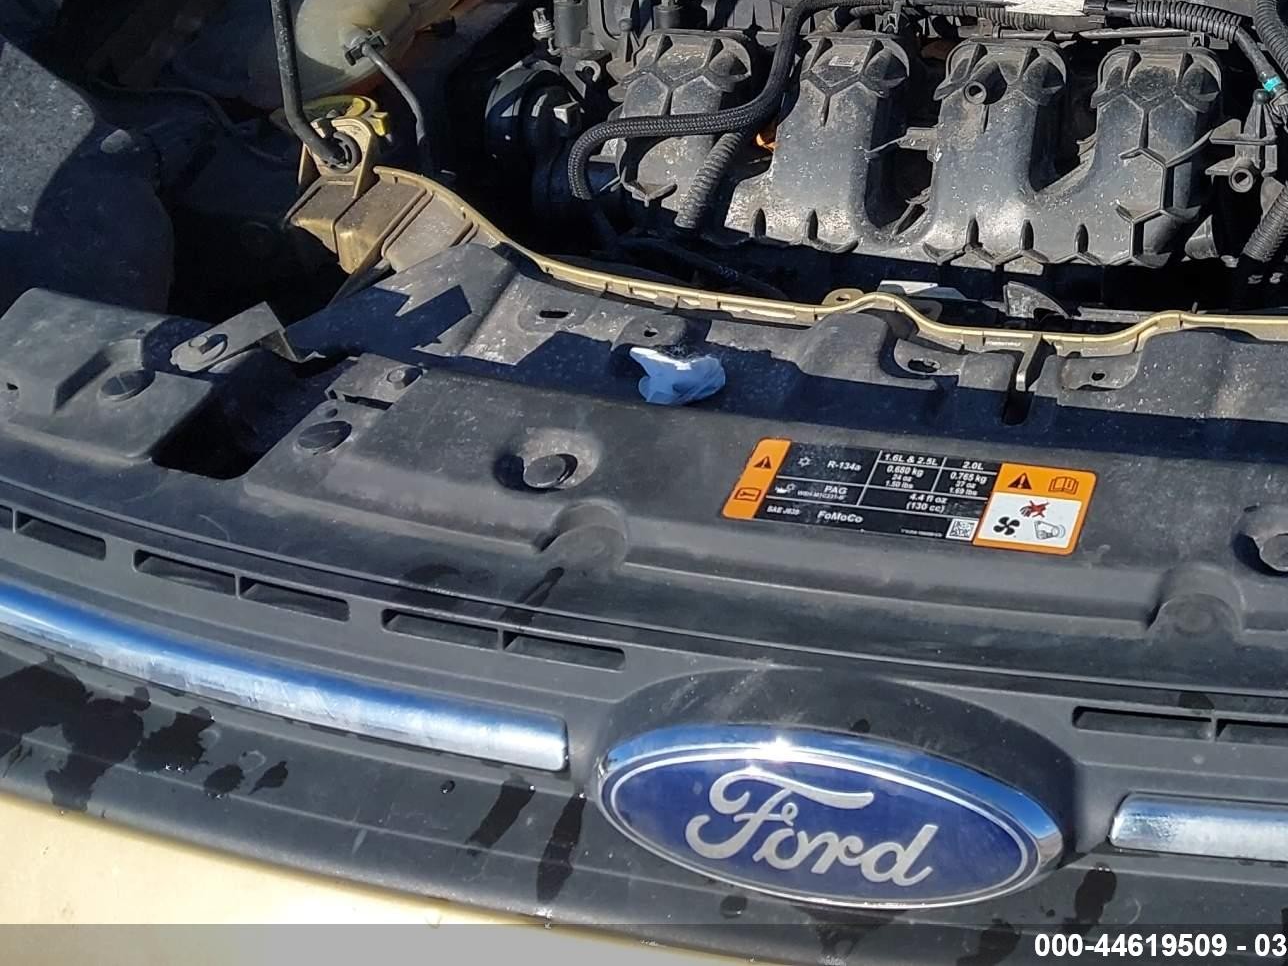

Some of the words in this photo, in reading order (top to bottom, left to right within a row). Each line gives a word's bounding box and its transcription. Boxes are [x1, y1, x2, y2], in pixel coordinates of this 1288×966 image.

[884, 453, 905, 462] 1.6L
[906, 455, 915, 463] &
[917, 457, 938, 466] 2.5L
[827, 460, 862, 472] R-134a
[962, 461, 984, 470] 2.0L
[886, 465, 910, 474] 0.680
[911, 467, 924, 478] kg
[950, 472, 974, 481] 0.765
[975, 474, 987, 484] kg
[824, 485, 848, 495] PAG
[901, 481, 914, 489] lbs
[965, 488, 978, 496] lbs
[925, 494, 934, 502] fl
[906, 502, 928, 511] (130
[929, 504, 945, 513] cc)
[817, 510, 864, 524] FoMoCo
[685, 767, 938, 887] Ford
